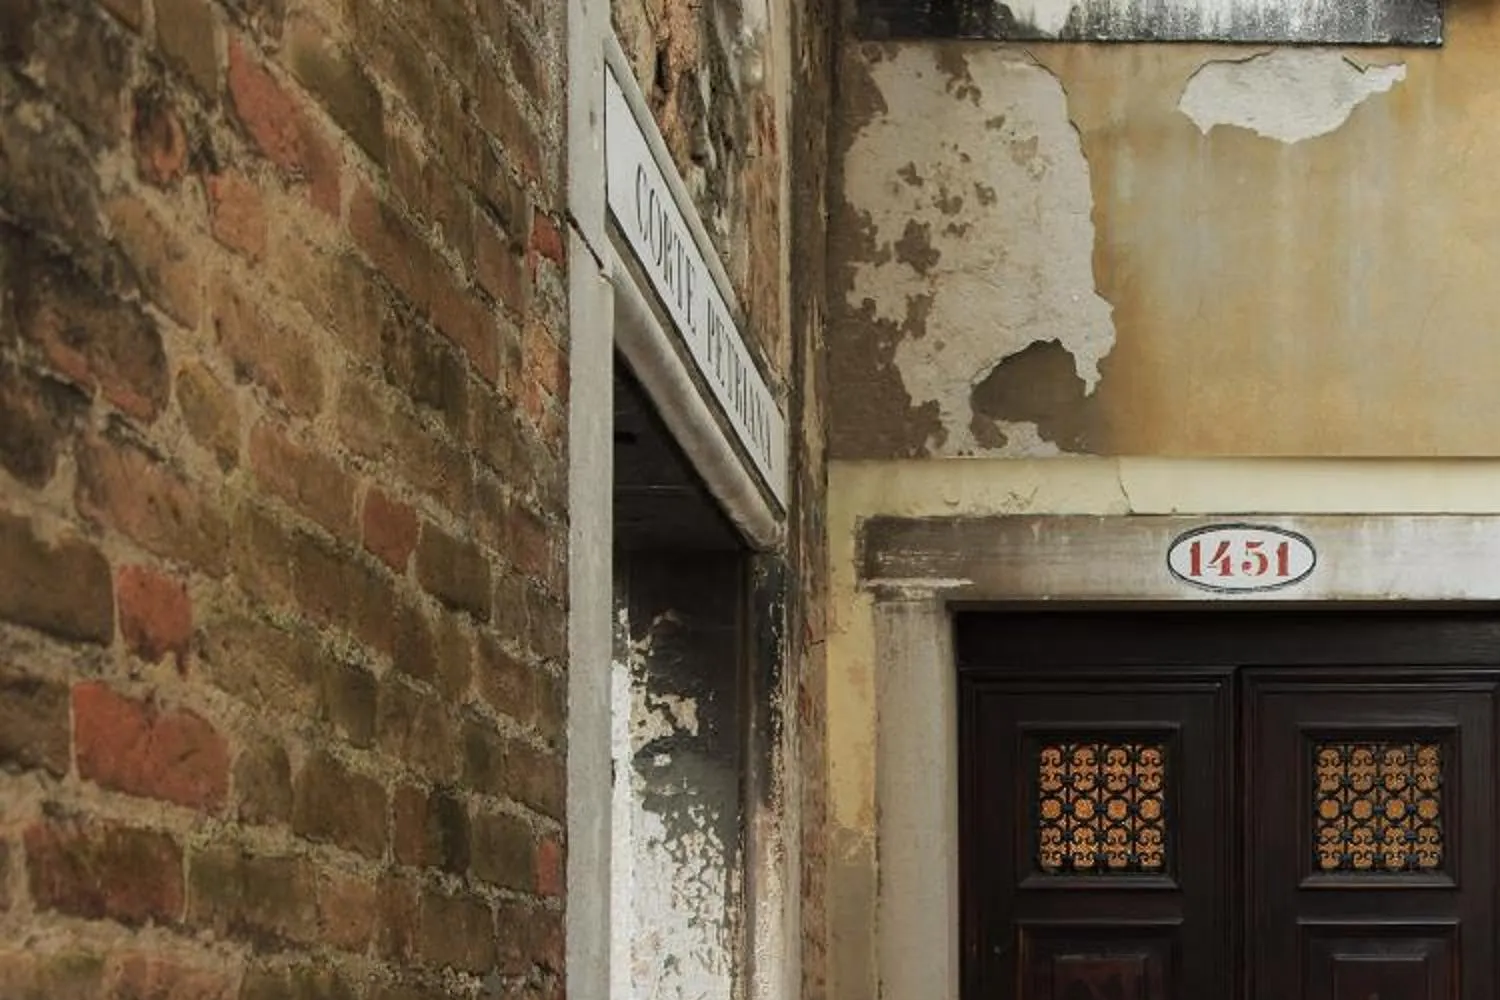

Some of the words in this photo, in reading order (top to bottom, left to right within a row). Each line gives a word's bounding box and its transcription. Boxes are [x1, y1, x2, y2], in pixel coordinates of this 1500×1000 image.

[634, 162, 698, 338] CORTE
[706, 298, 773, 472] PETRIANA
[1189, 540, 1289, 577] 1451
